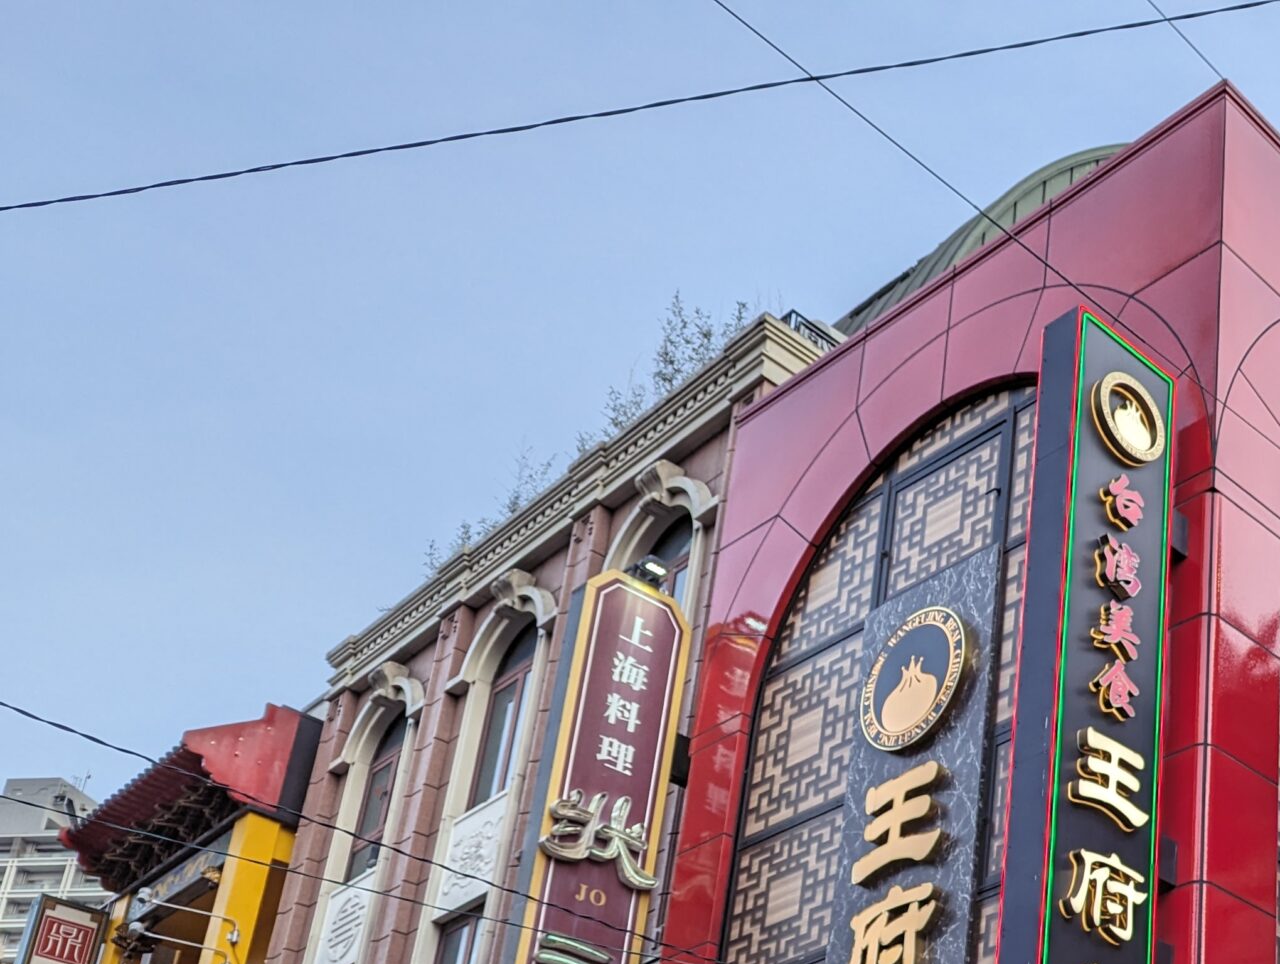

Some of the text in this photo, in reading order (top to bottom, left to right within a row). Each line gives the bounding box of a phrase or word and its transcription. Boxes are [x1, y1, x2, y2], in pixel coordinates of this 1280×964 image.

[596, 615, 655, 778] 上海料理
[575, 884, 607, 906] JO
